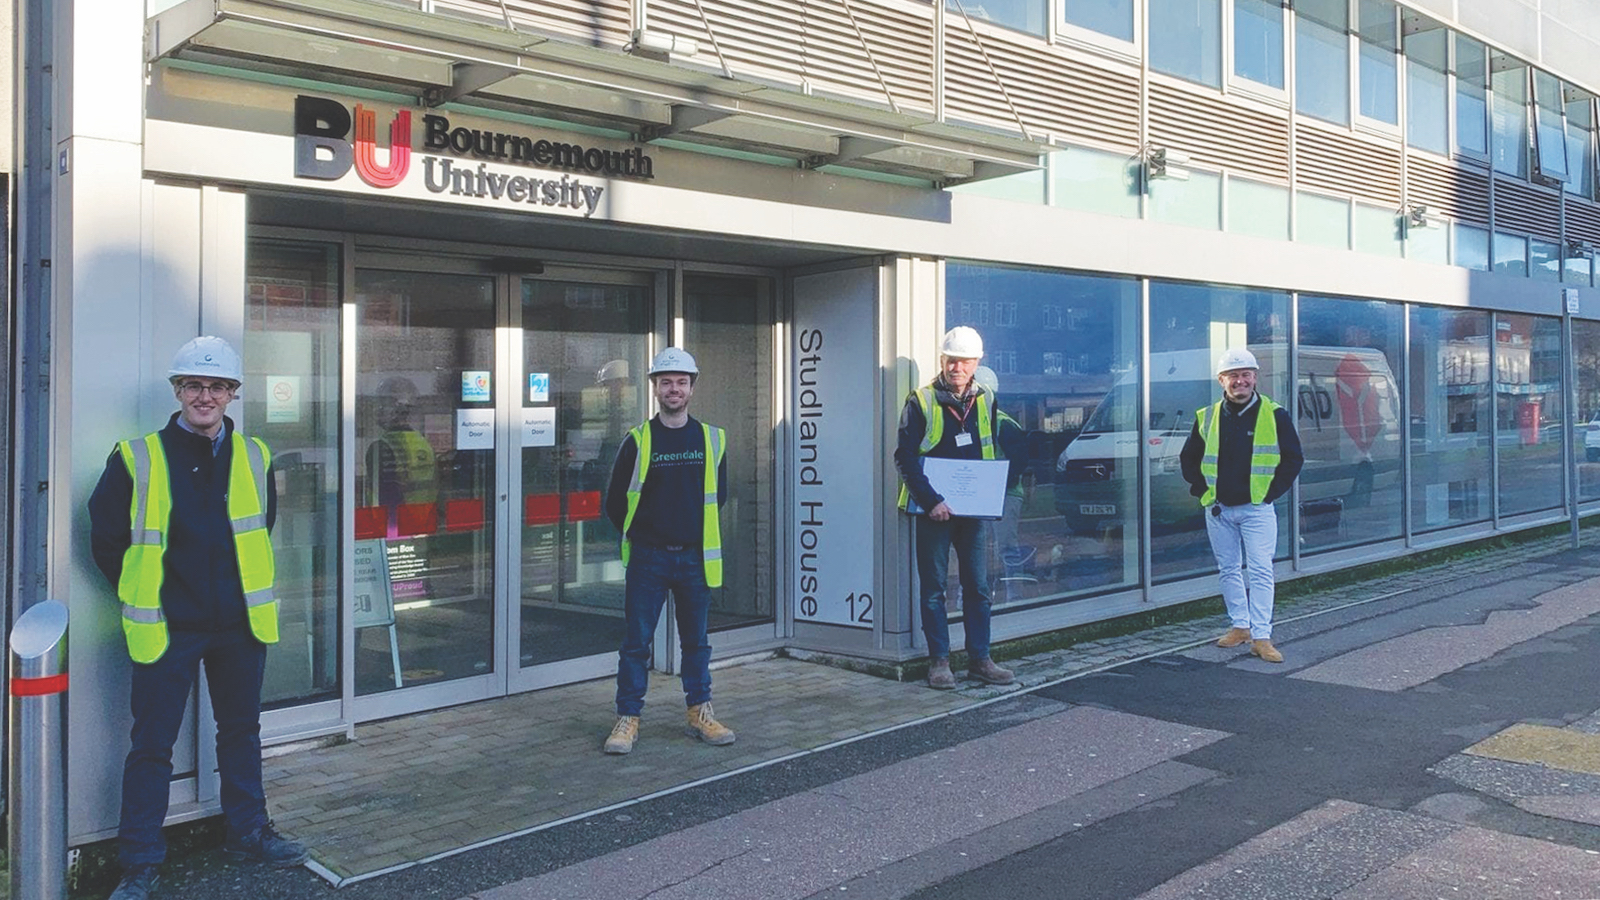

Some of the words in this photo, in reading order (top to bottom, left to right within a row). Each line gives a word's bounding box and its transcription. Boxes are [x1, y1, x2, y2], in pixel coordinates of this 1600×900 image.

[294, 94, 411, 188] BU
[422, 113, 655, 179] Bournemouth
[422, 155, 604, 218] University
[800, 329, 823, 486] Studland
[651, 450, 704, 462] Greendale
[400, 545, 415, 553] Box
[800, 501, 823, 617] House
[845, 592, 873, 623] 12
